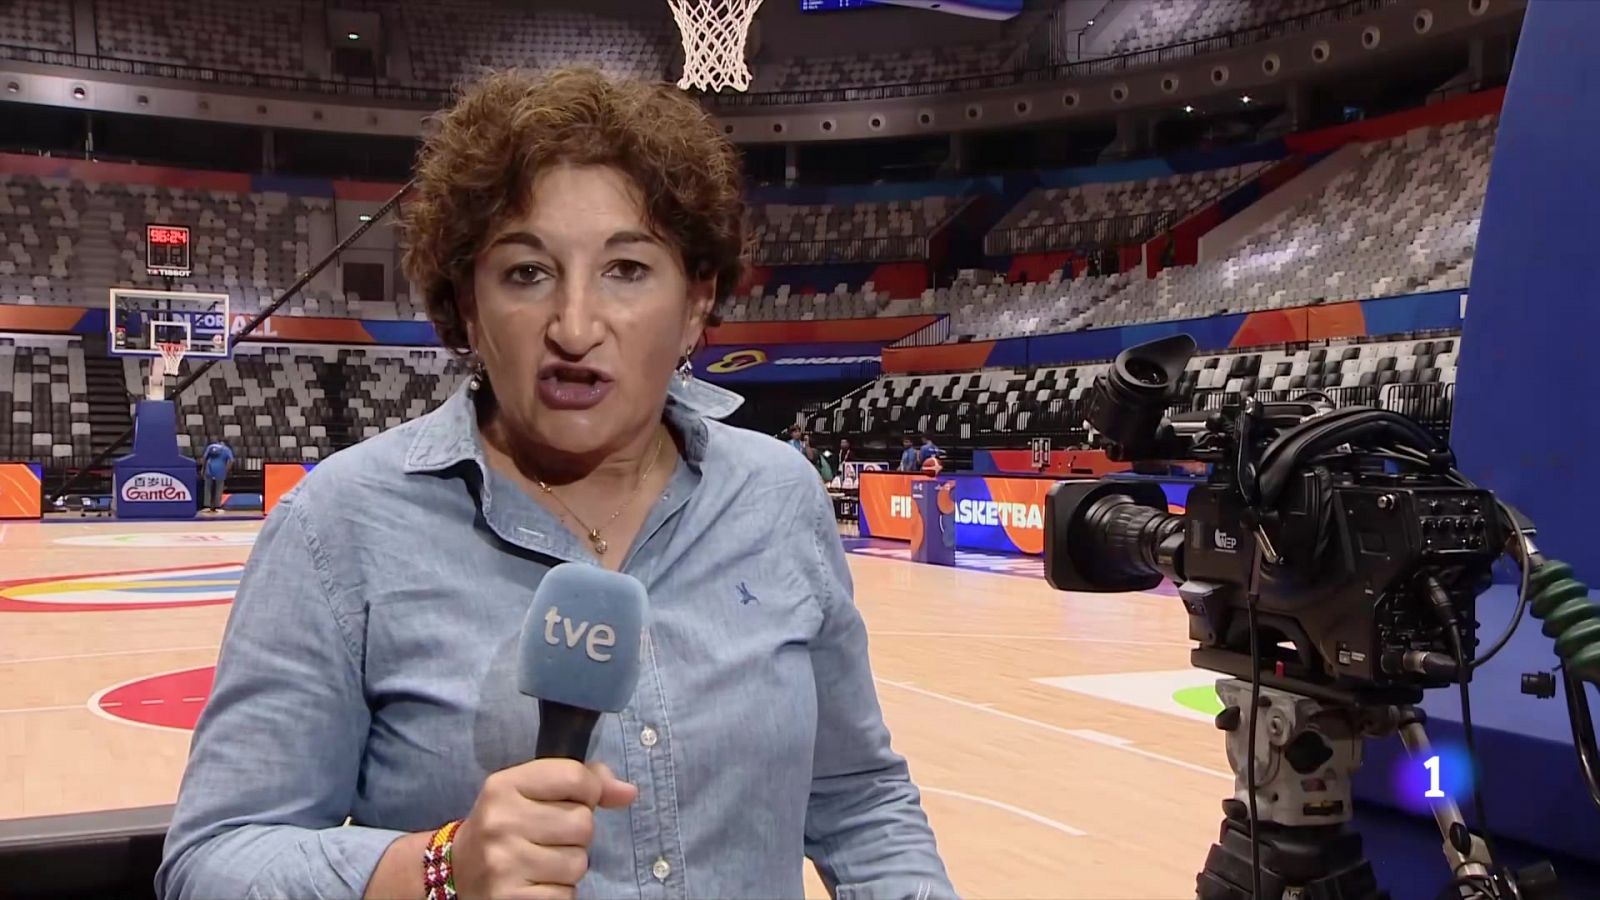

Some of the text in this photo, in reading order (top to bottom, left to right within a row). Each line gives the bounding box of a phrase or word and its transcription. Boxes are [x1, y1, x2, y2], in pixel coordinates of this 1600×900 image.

[160, 269, 191, 277] TISSOT
[135, 477, 173, 487] 百岁山
[544, 606, 616, 662] tve
